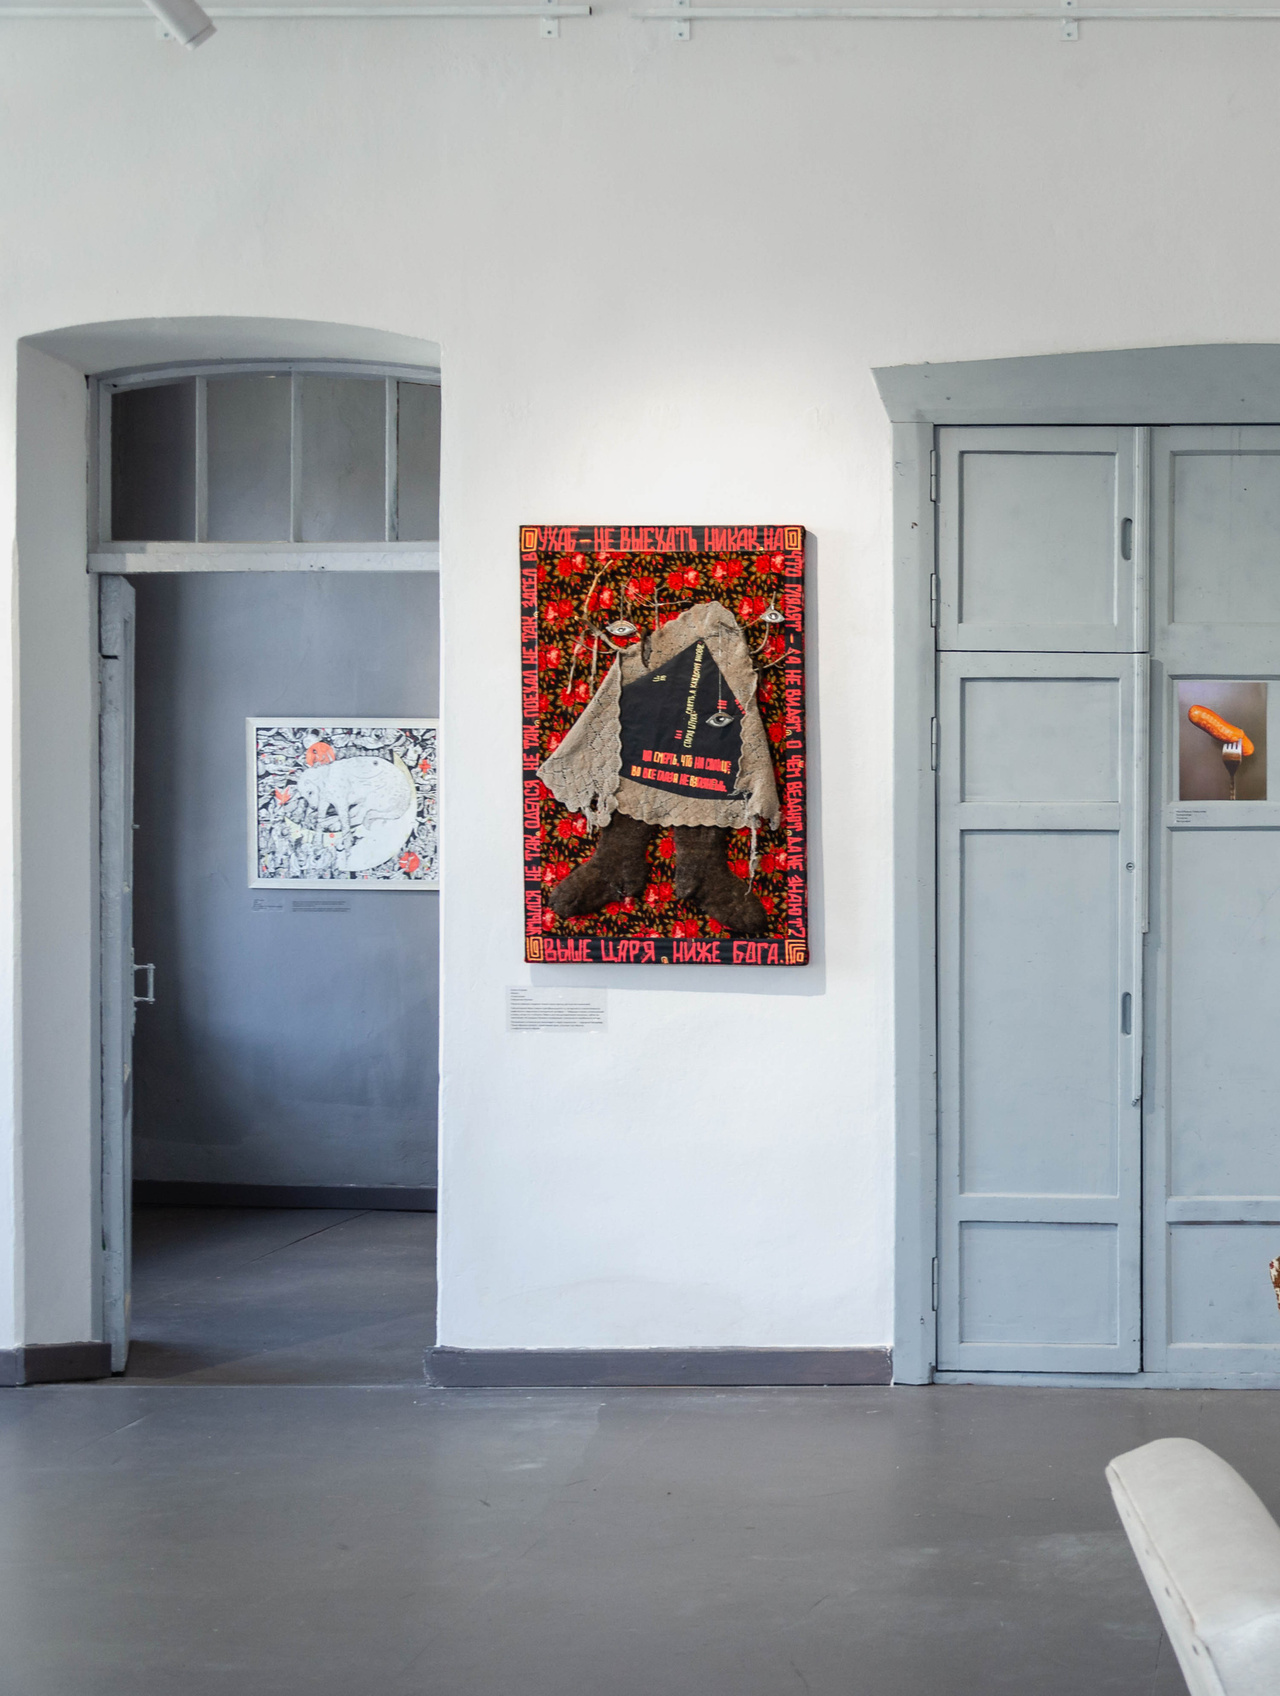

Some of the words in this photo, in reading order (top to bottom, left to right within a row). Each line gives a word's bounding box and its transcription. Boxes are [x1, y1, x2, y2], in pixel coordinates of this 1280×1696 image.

[537, 527, 579, 551] УХАБ
[594, 528, 615, 551] НЕ
[620, 527, 697, 551] ВЫЕХАТЬ
[764, 527, 784, 551] НА
[521, 552, 537, 561] В
[785, 551, 802, 577] ЧТО
[785, 584, 802, 632] ГЛЯДЯТ
[522, 646, 538, 664] НЕ
[786, 669, 802, 685] НЕ
[523, 670, 539, 717] ПОЕХАЛ
[523, 753, 539, 770] НЕ
[524, 780, 540, 828] ОДЕЛСЯ
[787, 837, 803, 852] ДА
[787, 855, 803, 870] НЕ
[525, 866, 541, 881] НЕ
[526, 890, 542, 935] УМЫЛСЯ
[544, 939, 592, 963] ВЫШЕ
[673, 941, 722, 963] НИЖЕ
